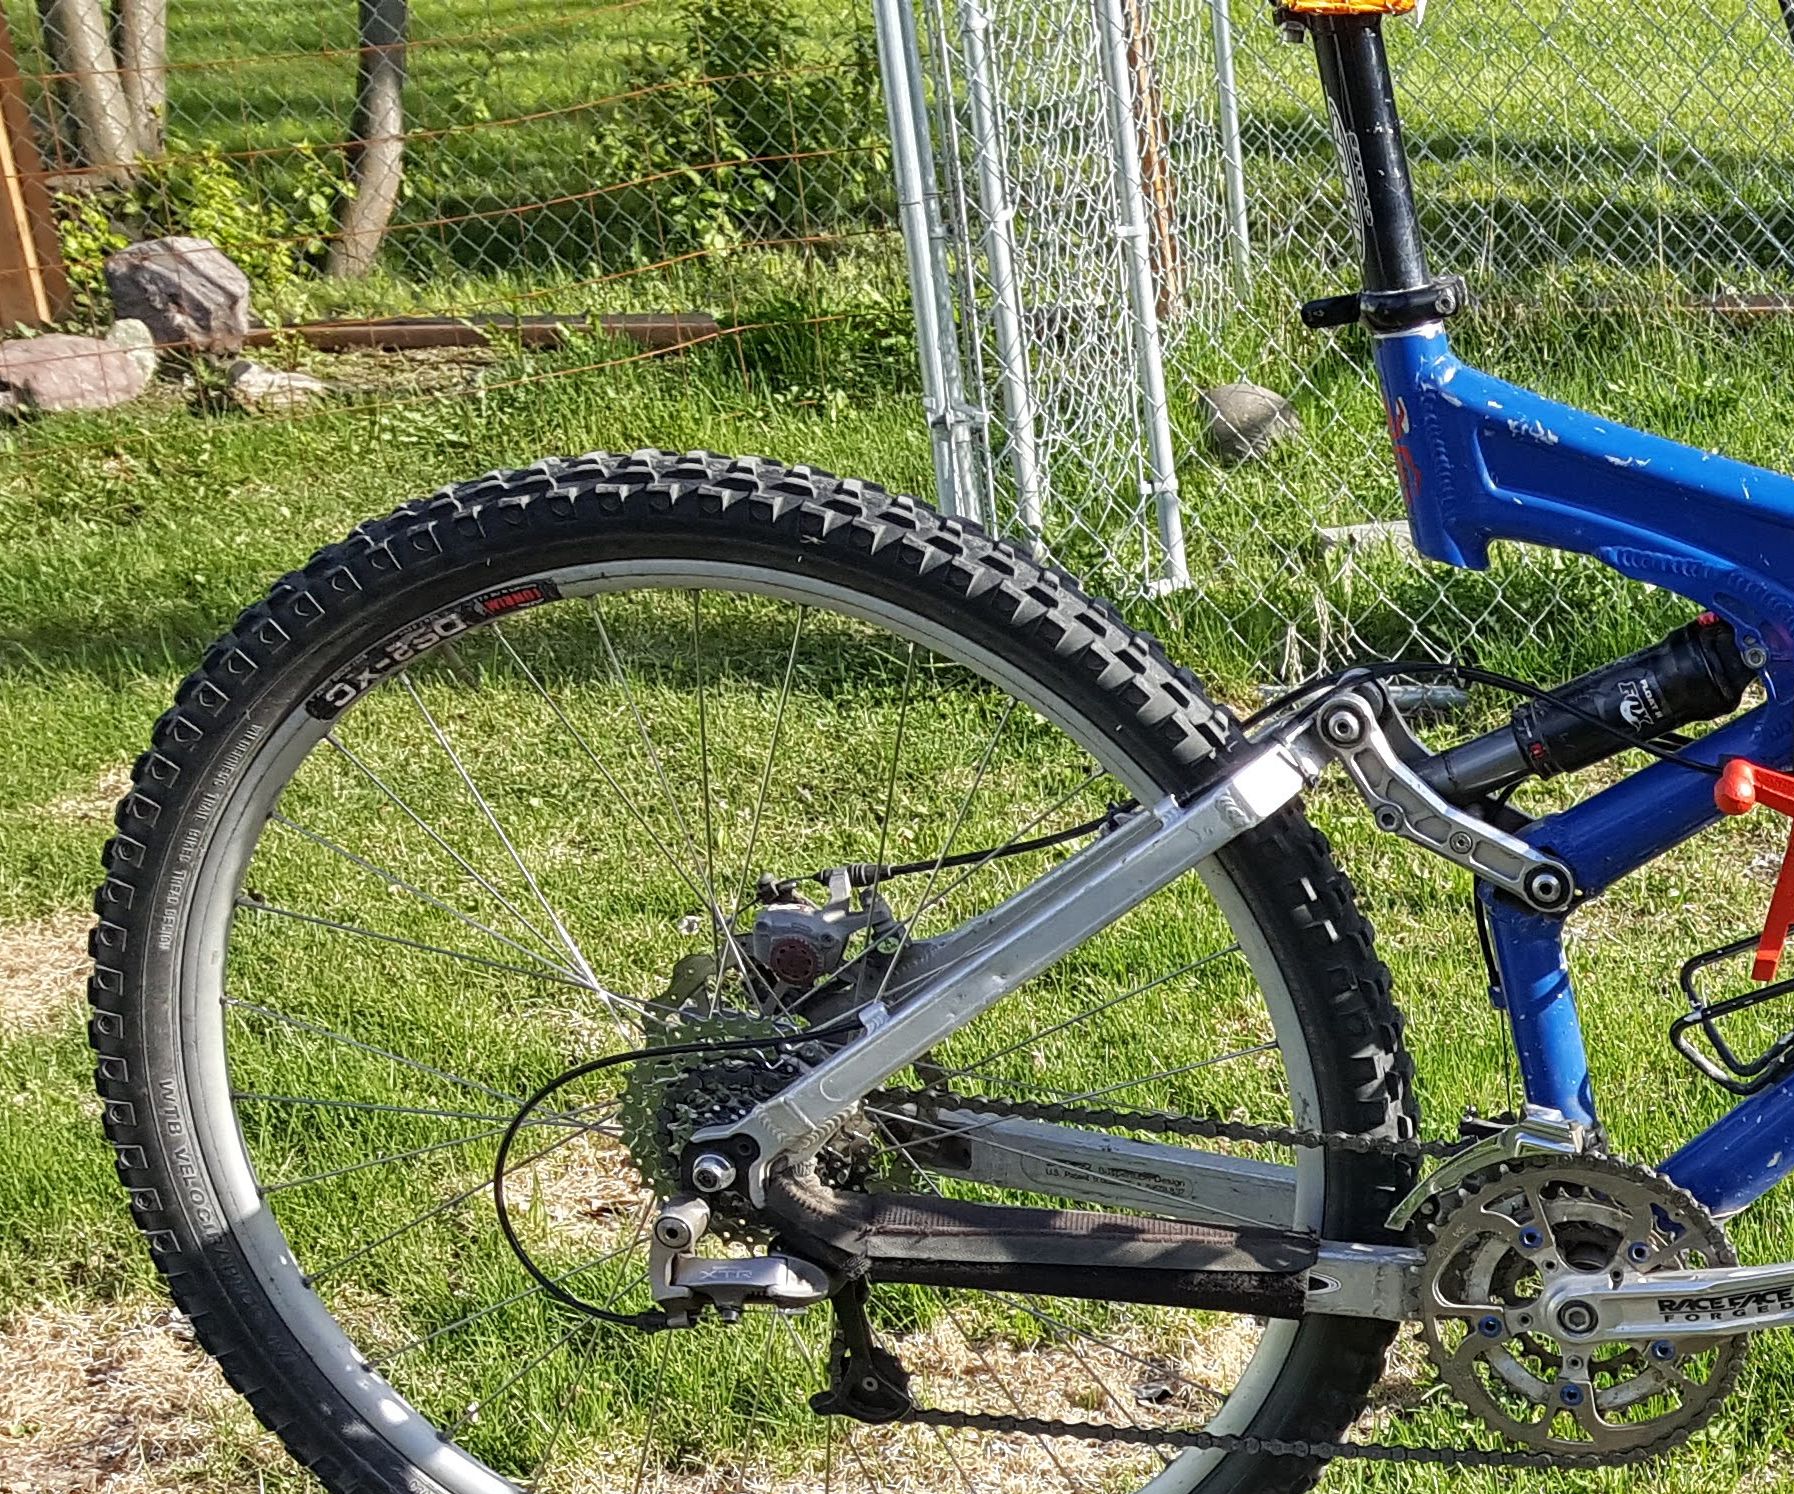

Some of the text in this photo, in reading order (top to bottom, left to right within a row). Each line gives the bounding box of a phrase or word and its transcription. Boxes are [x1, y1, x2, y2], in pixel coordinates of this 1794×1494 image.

[1618, 681, 1655, 732] FOX
[1639, 679, 1660, 714] FLOAT
[194, 792, 220, 823] TRAIL
[158, 1077, 183, 1136] WTB
[700, 1269, 753, 1279] XTR
